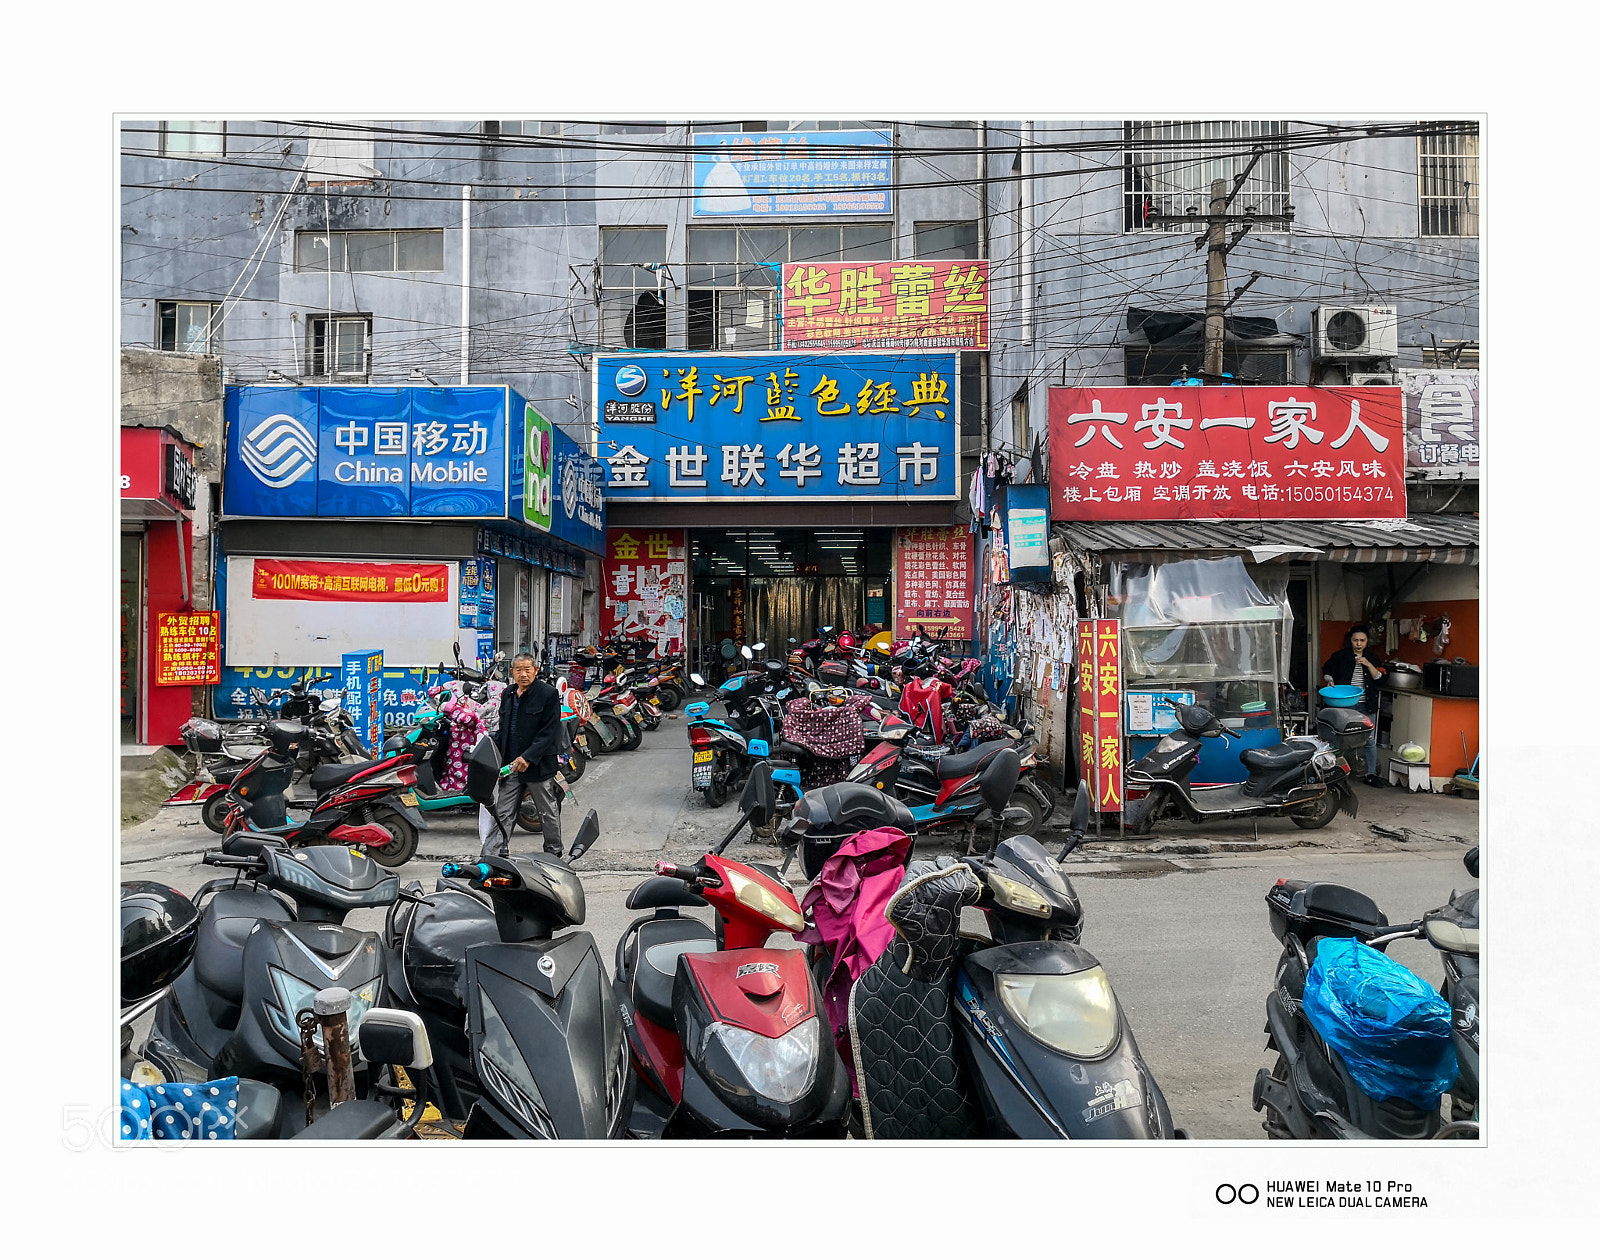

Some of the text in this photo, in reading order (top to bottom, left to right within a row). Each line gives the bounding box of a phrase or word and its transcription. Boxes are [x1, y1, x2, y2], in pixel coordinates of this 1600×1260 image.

[786, 264, 987, 317] 华胜蕾丝
[606, 402, 653, 414] 洋河股份
[1417, 384, 1476, 442] 食
[1067, 396, 1391, 452] 六安一家人
[335, 420, 488, 456] 中国移动
[335, 460, 488, 483] China Mobile
[606, 442, 940, 488] 金世联华超市
[1069, 460, 1387, 480] 冷盘 热炒 盖浇饭 六安风味
[1063, 486, 1142, 504] 楼上包厢
[1153, 484, 1232, 503] 空调开放
[611, 532, 673, 559] 金世
[906, 526, 968, 541] 华胜蕾丝
[167, 616, 210, 626] 外贸招聘
[916, 609, 951, 617] 向前右边
[1080, 624, 1095, 803] 六安一家人
[1099, 626, 1121, 806] 六安一家人
